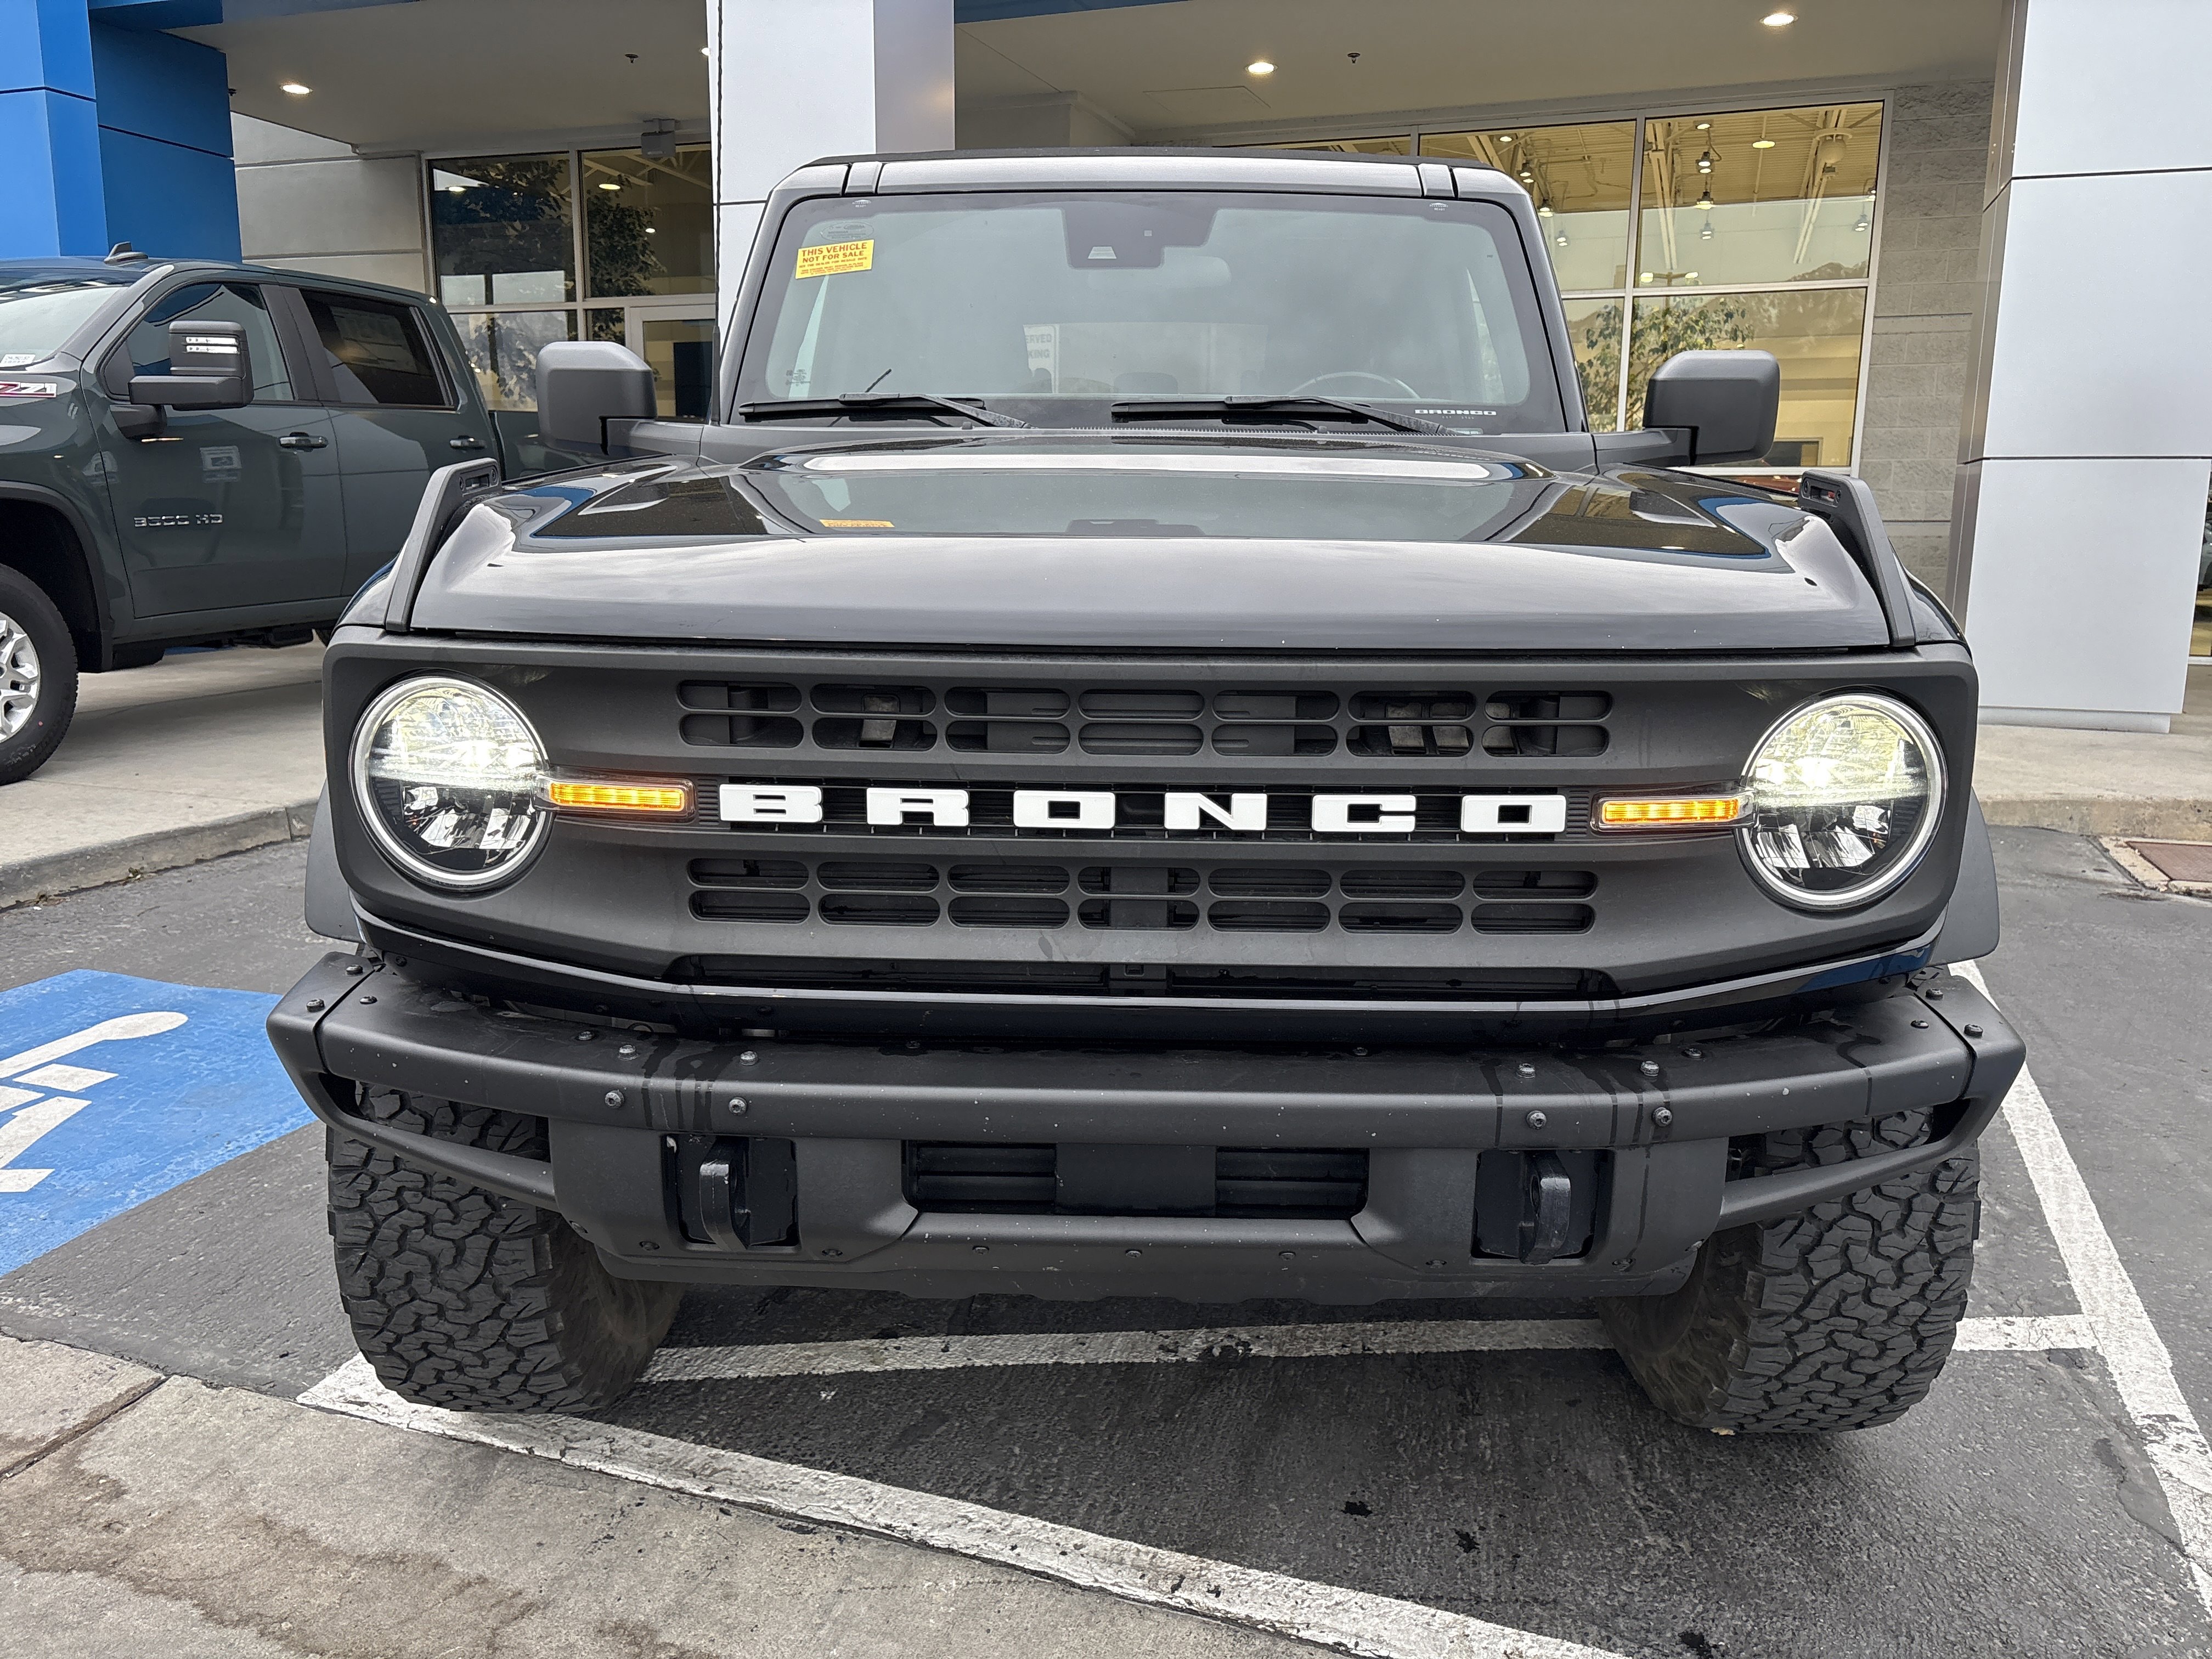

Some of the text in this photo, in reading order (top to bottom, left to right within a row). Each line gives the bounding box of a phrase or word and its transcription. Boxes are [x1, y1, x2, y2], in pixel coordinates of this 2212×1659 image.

[802, 242, 867, 257] THIS VEHICLE
[134, 514, 223, 527] 3500 HD
[719, 783, 1566, 833] BRONCO
